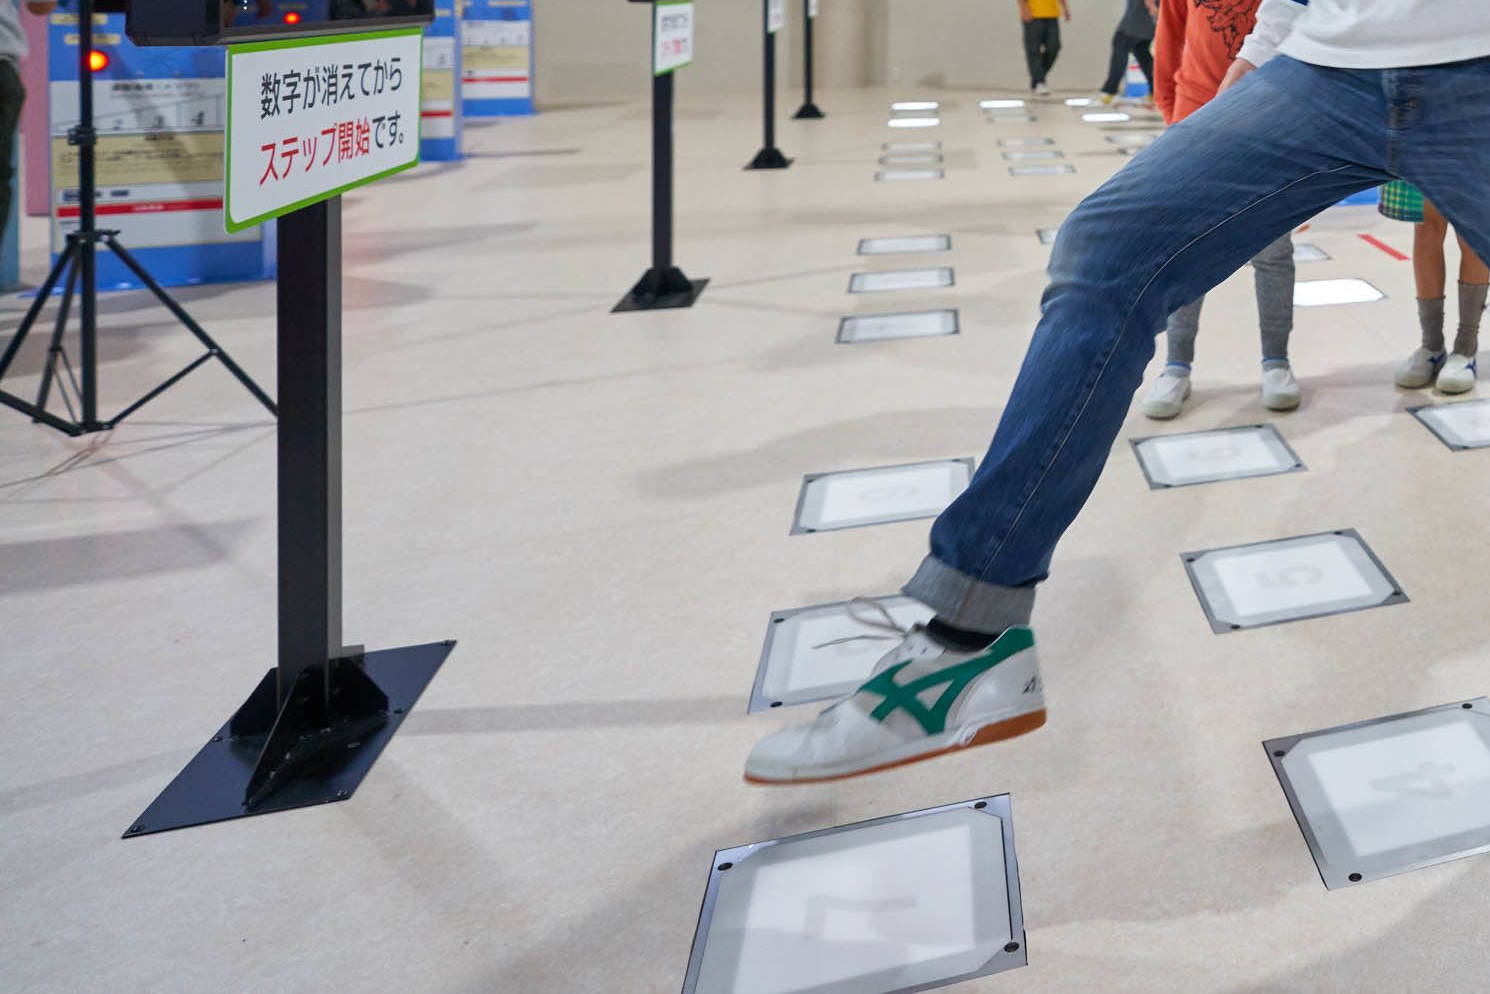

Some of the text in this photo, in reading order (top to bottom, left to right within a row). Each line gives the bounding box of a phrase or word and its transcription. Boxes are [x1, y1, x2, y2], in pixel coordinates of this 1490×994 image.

[260, 57, 402, 119] 数字が消えてから
[259, 110, 404, 187] ステップ開始です。
